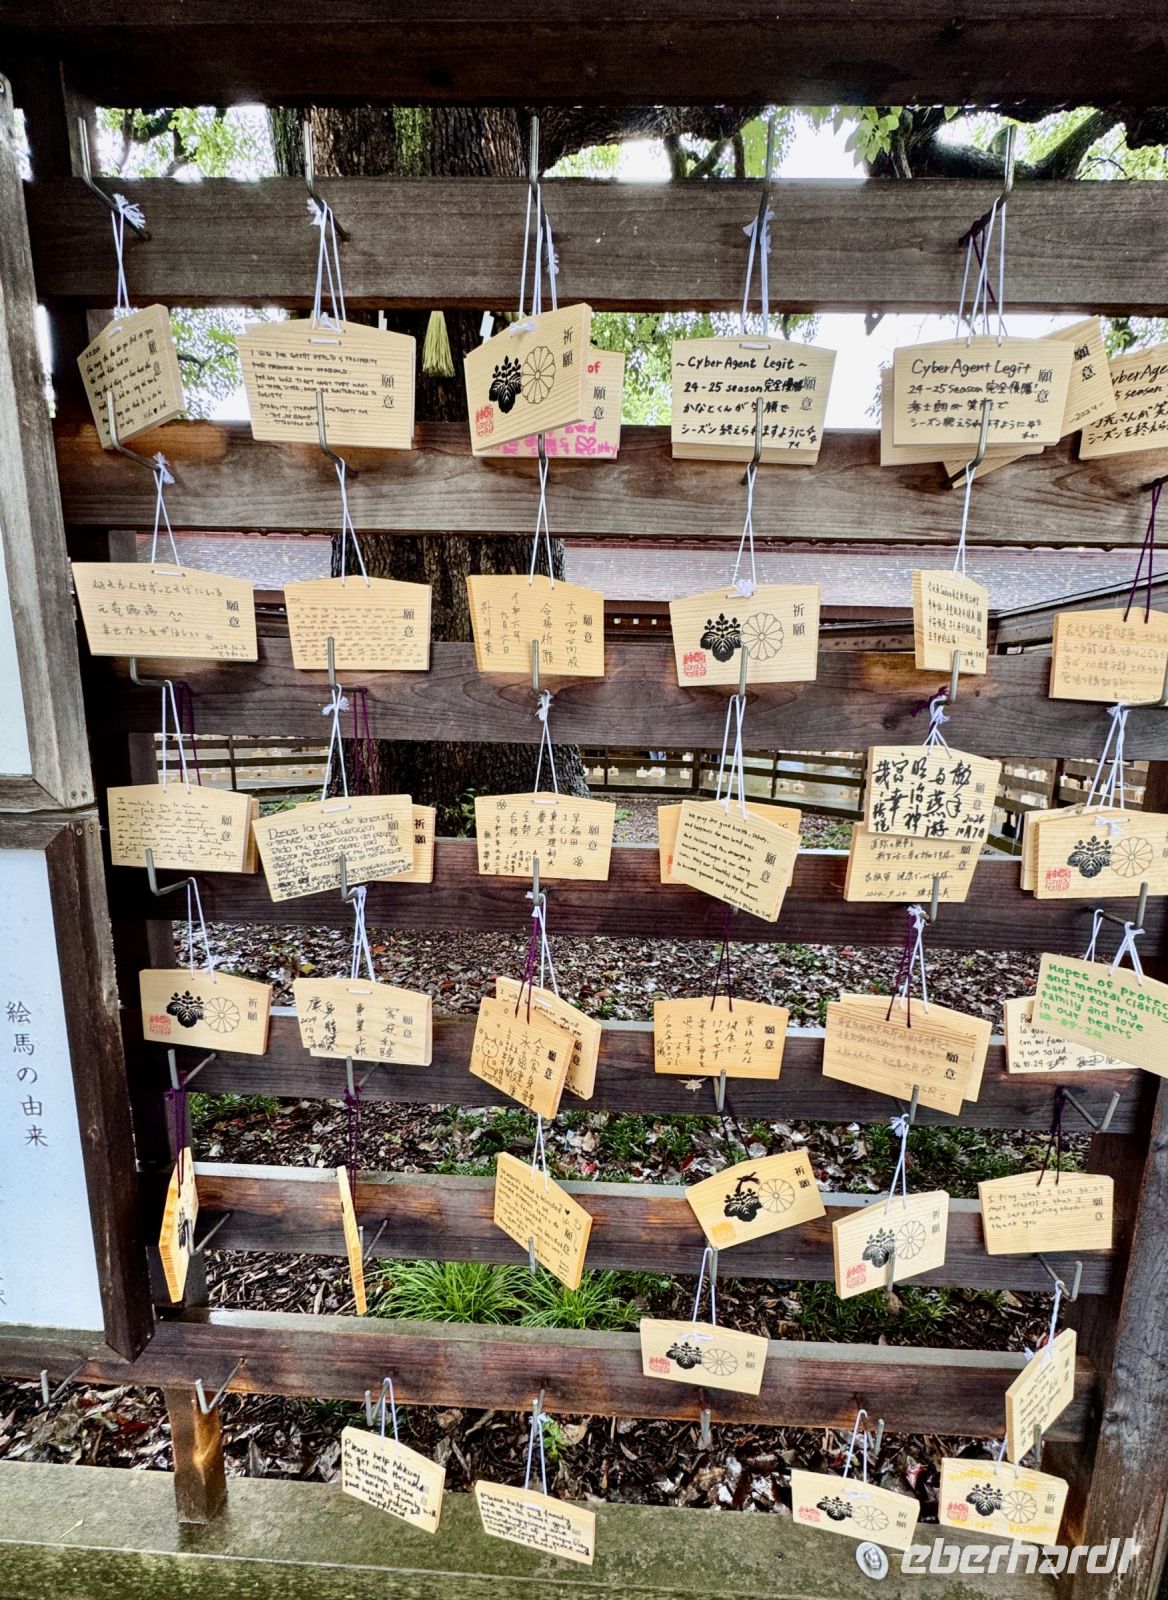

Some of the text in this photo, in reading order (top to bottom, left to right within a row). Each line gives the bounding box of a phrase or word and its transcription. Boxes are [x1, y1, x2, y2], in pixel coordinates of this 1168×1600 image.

[562, 327, 573, 367] 祈願
[587, 361, 601, 373] of
[763, 357, 795, 371] Legit
[994, 362, 1031, 378] Legit
[1074, 344, 1096, 382] 願意
[381, 373, 395, 409] 願意
[799, 376, 817, 411] 願意
[1035, 369, 1053, 403] 願意
[1124, 385, 1162, 400] season
[593, 386, 606, 420] 願意
[226, 600, 241, 628] 願意
[403, 608, 415, 638] 願意
[793, 603, 805, 636] 祈願
[540, 603, 554, 665] 合格祈願
[583, 614, 593, 644] 願意
[973, 783, 985, 810] 願意
[221, 815, 233, 842] 願意
[414, 818, 426, 844] 祈願
[521, 811, 531, 836] 全部
[570, 812, 581, 846] 早稲田
[963, 814, 985, 824] 2024
[547, 810, 557, 867] 東京理科大
[588, 824, 600, 851] 願意
[760, 852, 777, 884] 願意
[956, 845, 971, 870] 願意
[1046, 973, 1070, 985] and
[1074, 981, 1120, 1002] mental
[1097, 979, 1113, 988] of
[247, 997, 258, 1022] 祈願
[1039, 999, 1131, 1039] in our hearts
[1041, 990, 1143, 1031] family and love
[1089, 995, 1109, 1008] for
[1115, 1005, 1138, 1020] my
[402, 1015, 413, 1038] 願意
[764, 1026, 775, 1050] 願意
[6, 1000, 48, 1147] 絵馬の由来
[944, 1052, 959, 1080] 願意
[794, 1165, 810, 1189] 祈願
[344, 1449, 351, 1458] to
[355, 1456, 369, 1467] get
[372, 1451, 389, 1466] help
[1044, 1493, 1056, 1515] 祈願
